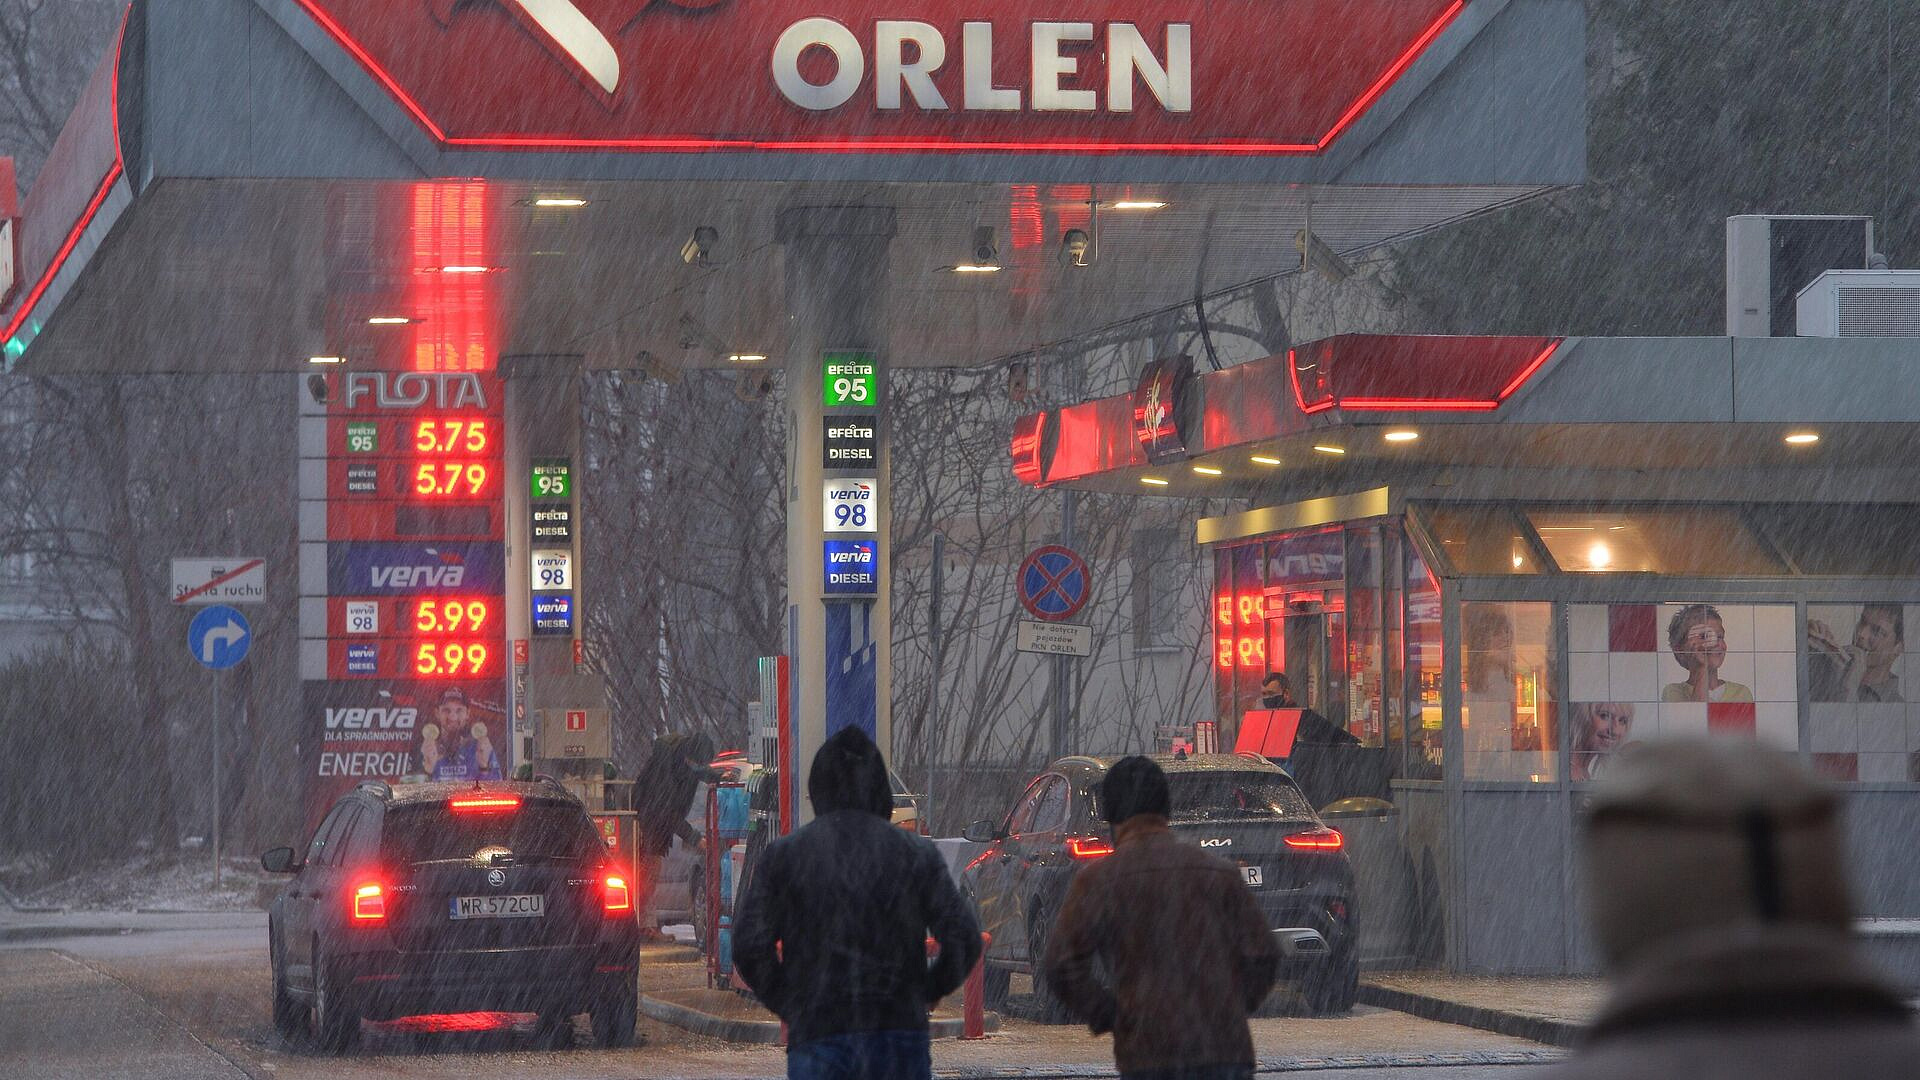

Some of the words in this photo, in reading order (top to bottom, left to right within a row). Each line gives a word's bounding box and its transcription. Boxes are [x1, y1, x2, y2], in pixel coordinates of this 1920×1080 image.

[771, 17, 1192, 112] ORLEN
[345, 372, 487, 409] FLOTA
[833, 378, 868, 402] 95
[351, 436, 373, 451] 95
[416, 421, 487, 452] 5.75
[829, 448, 873, 459] DIESEL
[349, 482, 376, 490] DIESEL
[416, 464, 487, 495] 5.79
[538, 476, 564, 494] 95
[829, 489, 871, 500] verva
[834, 503, 867, 527] 98
[535, 526, 568, 536] DIESEL
[537, 558, 567, 566] verva
[829, 551, 872, 563] verva
[371, 564, 465, 588] verva
[540, 568, 564, 586] 98
[829, 573, 873, 584] DIESEL
[224, 583, 262, 596] ruchu
[537, 603, 569, 613] verva
[350, 607, 375, 615] verva
[416, 601, 487, 632] 5.99
[352, 616, 373, 630] 98
[537, 619, 569, 628] DIESEL
[1032, 623, 1045, 631] Nie
[1031, 642, 1047, 650] PKN
[1050, 644, 1077, 653] ORLEN
[349, 649, 375, 658] verva
[416, 643, 487, 674] 5.99
[348, 662, 376, 670] DIESEL
[325, 707, 418, 729] verva
[324, 731, 342, 741] DLA
[344, 731, 413, 741] SPRAGNIONYCH
[318, 752, 409, 777] ENERGII
[460, 899, 482, 914] WR
[489, 896, 541, 914] 572CU
